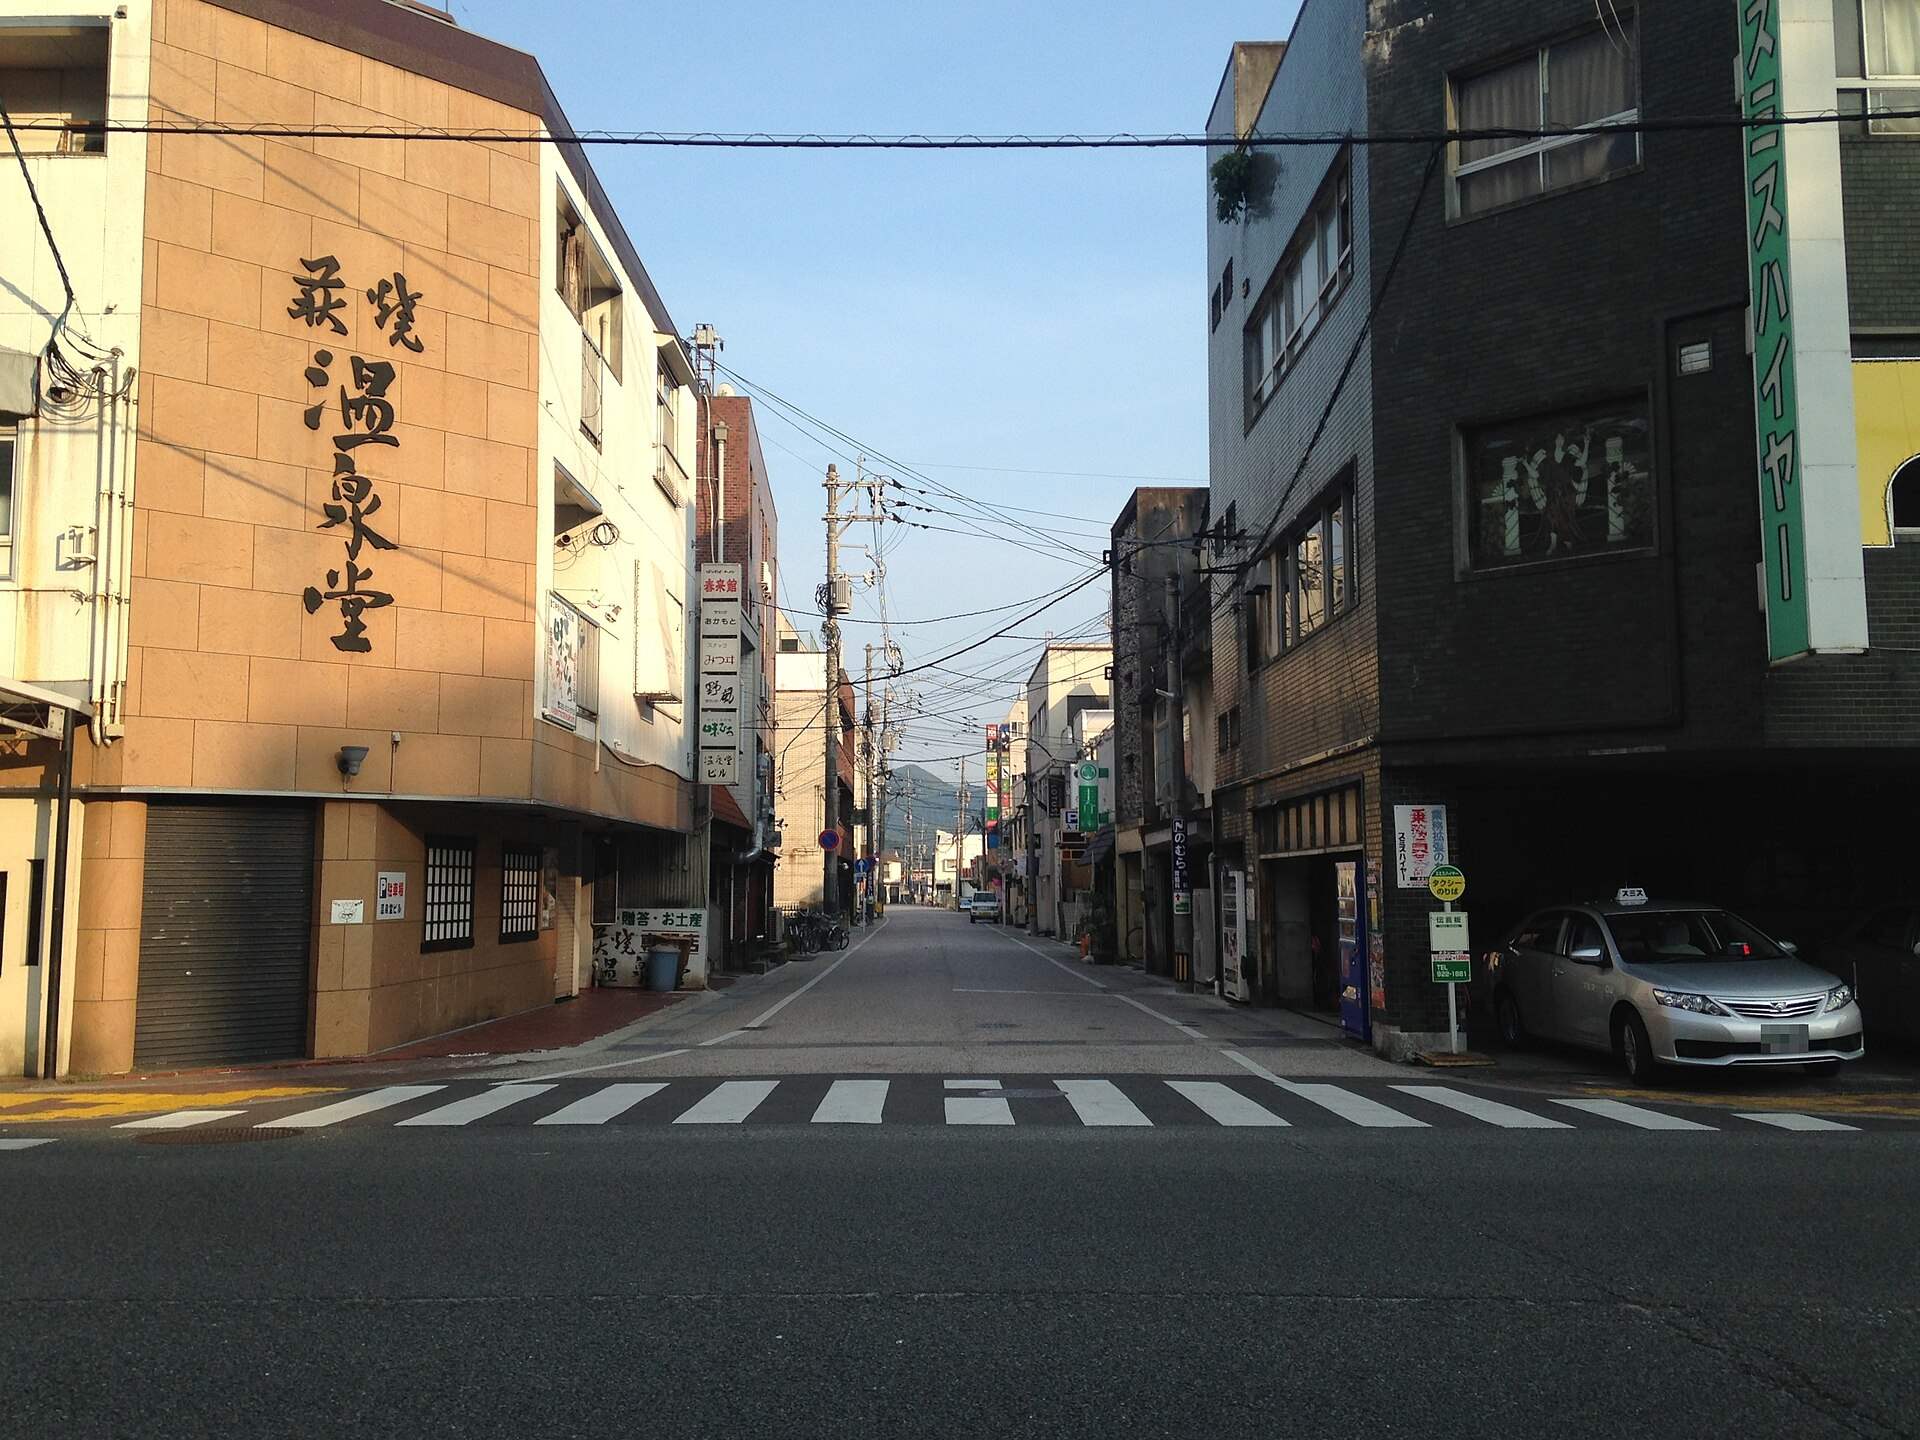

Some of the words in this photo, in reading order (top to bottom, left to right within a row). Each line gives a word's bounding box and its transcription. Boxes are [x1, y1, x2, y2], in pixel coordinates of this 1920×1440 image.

[1743, 0, 1795, 602] スミスハイヤー
[304, 349, 400, 653] 温泉堂
[704, 617, 737, 625] おかもと
[707, 768, 726, 778] ビル
[1174, 832, 1187, 870] のむら
[1398, 832, 1408, 881] スミスハイヤー
[1432, 879, 1461, 888] タクシー
[1437, 887, 1459, 896] のりば
[1622, 889, 1644, 897] スミス
